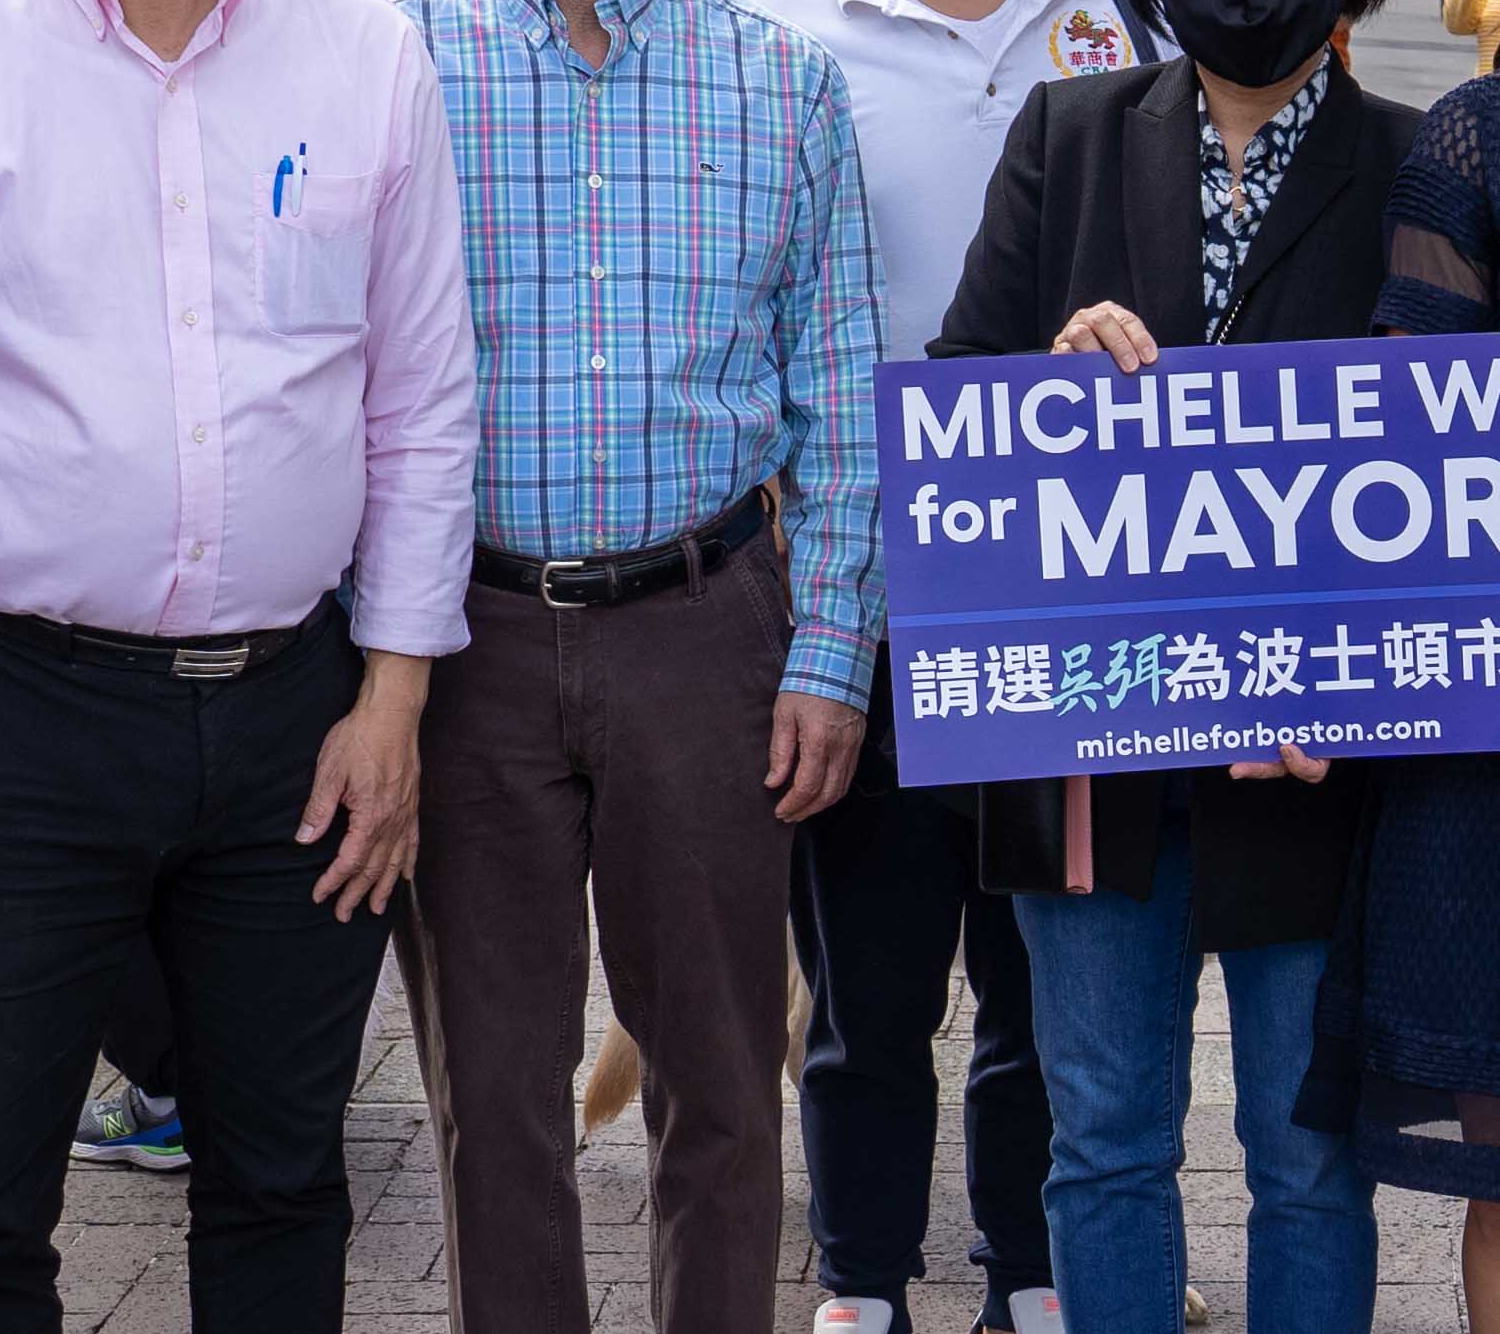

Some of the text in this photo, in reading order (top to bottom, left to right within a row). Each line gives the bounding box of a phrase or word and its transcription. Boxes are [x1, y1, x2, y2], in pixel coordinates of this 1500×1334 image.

[901, 363, 1385, 461] MICHELLE
[908, 483, 1016, 545] for
[1076, 715, 1443, 761] michelleforboston.com
